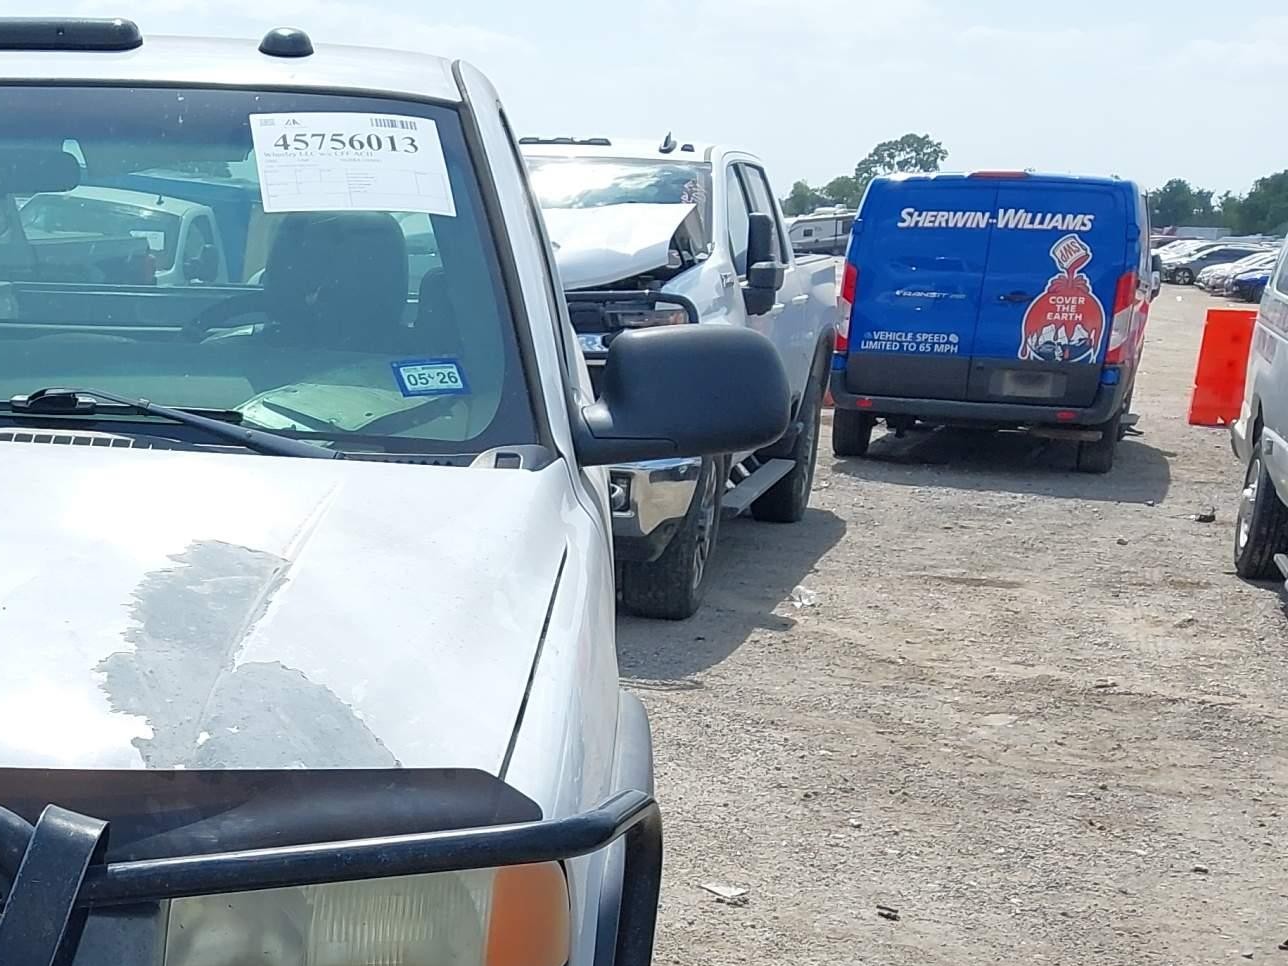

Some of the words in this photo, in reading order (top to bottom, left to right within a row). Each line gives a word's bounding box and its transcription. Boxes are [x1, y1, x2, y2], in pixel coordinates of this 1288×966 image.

[273, 133, 419, 154] 45756013
[1059, 240, 1081, 263] SWP
[1048, 296, 1085, 305] COVER
[1056, 304, 1077, 312] THE
[1046, 312, 1083, 321] EARTH
[873, 331, 912, 341] VEHICLE
[916, 333, 948, 343] SPEED
[860, 340, 900, 350] LIMITED
[902, 342, 917, 351] TO
[919, 343, 931, 352] 65
[934, 344, 959, 353] MPH
[406, 373, 430, 387] 05
[436, 371, 459, 385] 26
